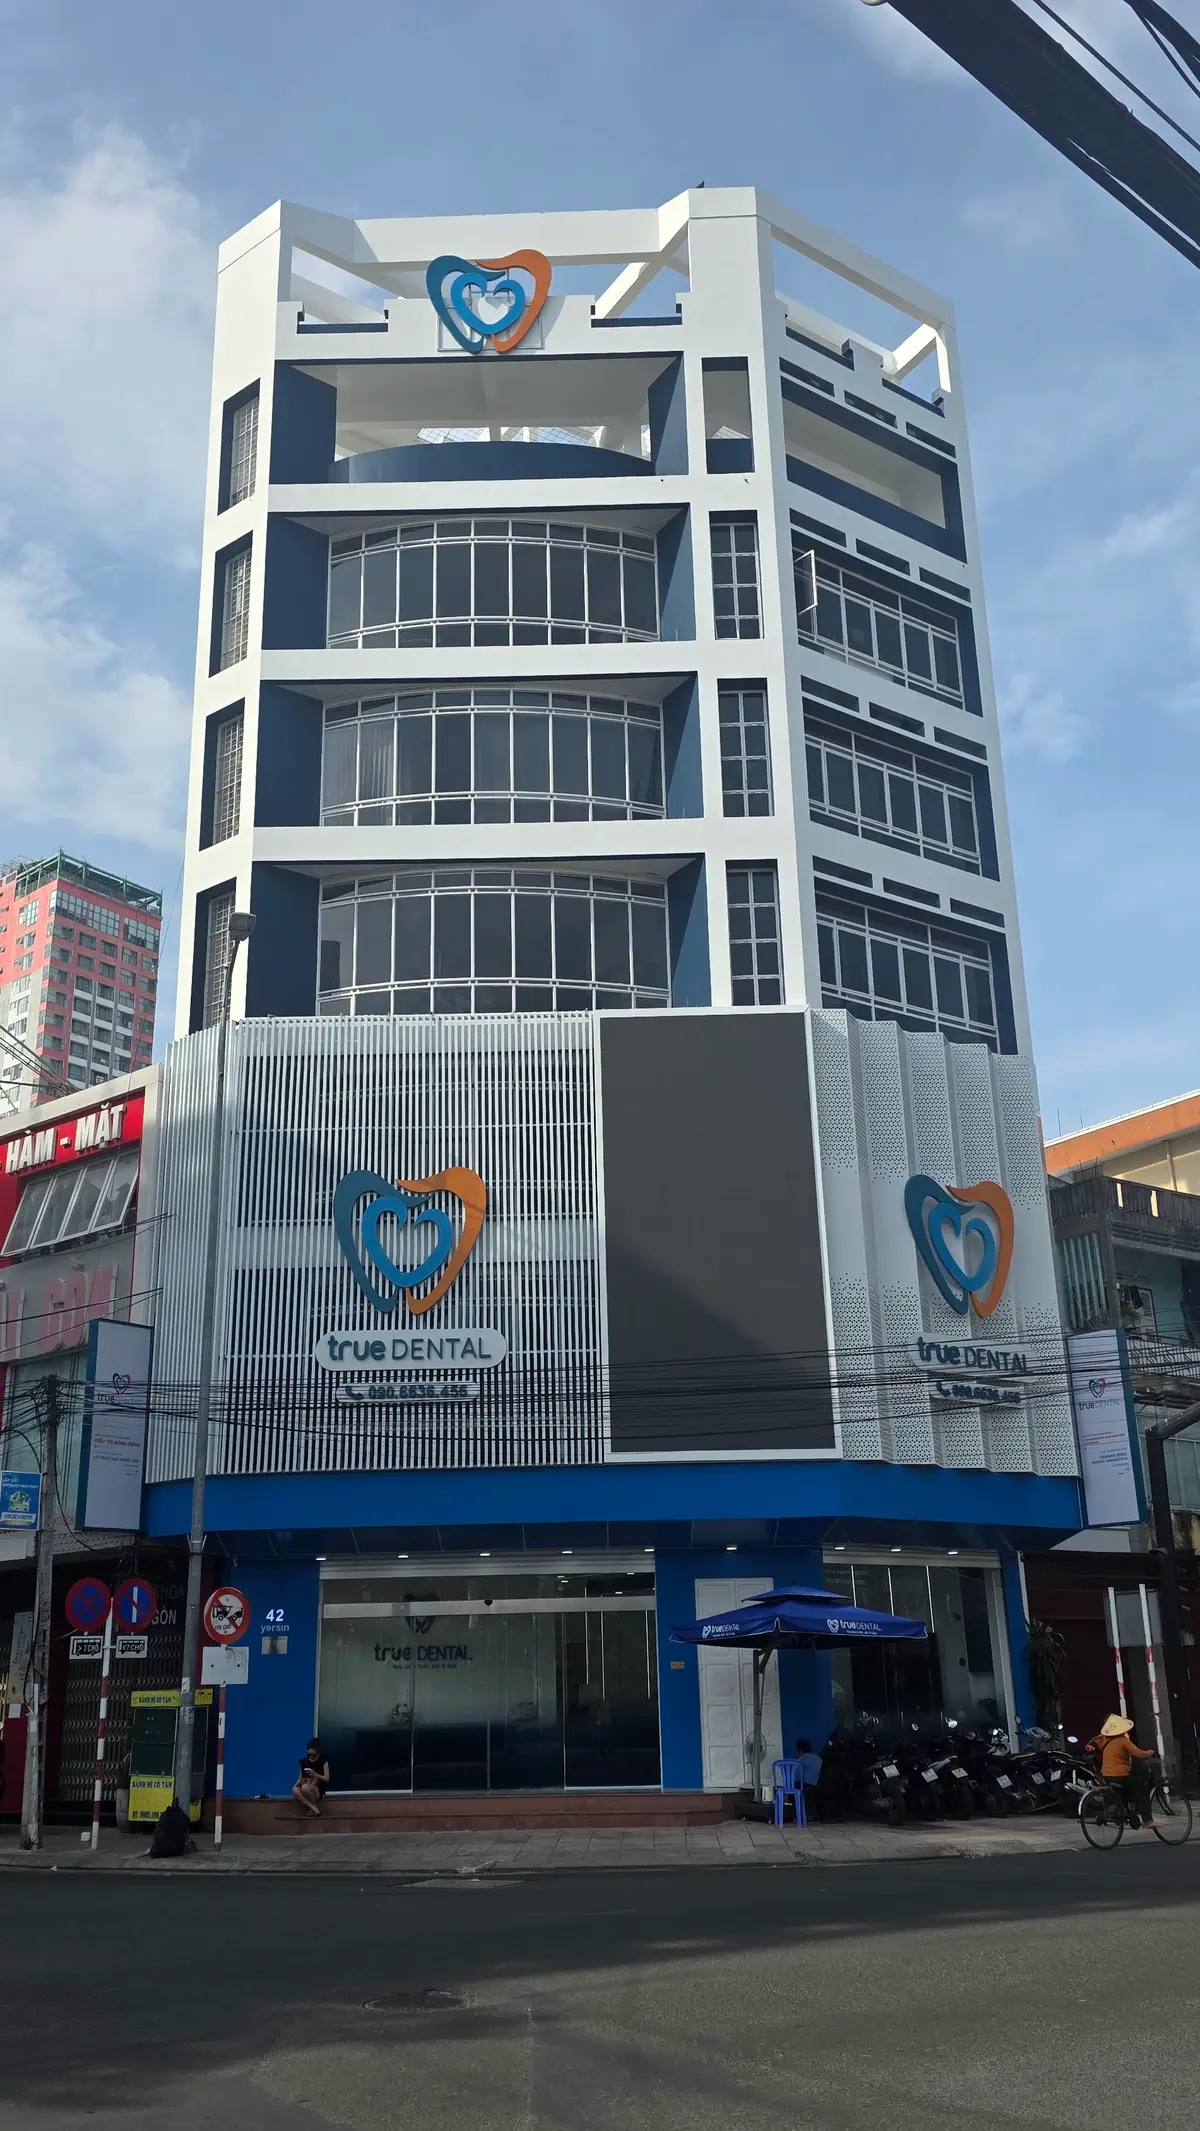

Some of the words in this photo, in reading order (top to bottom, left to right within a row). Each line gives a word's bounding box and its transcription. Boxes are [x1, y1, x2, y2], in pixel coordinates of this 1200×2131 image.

[5, 1129, 57, 1174] HÀM
[74, 1102, 125, 1149] MẶT
[265, 1608, 284, 1622] 42
[260, 1623, 290, 1634] yersin
